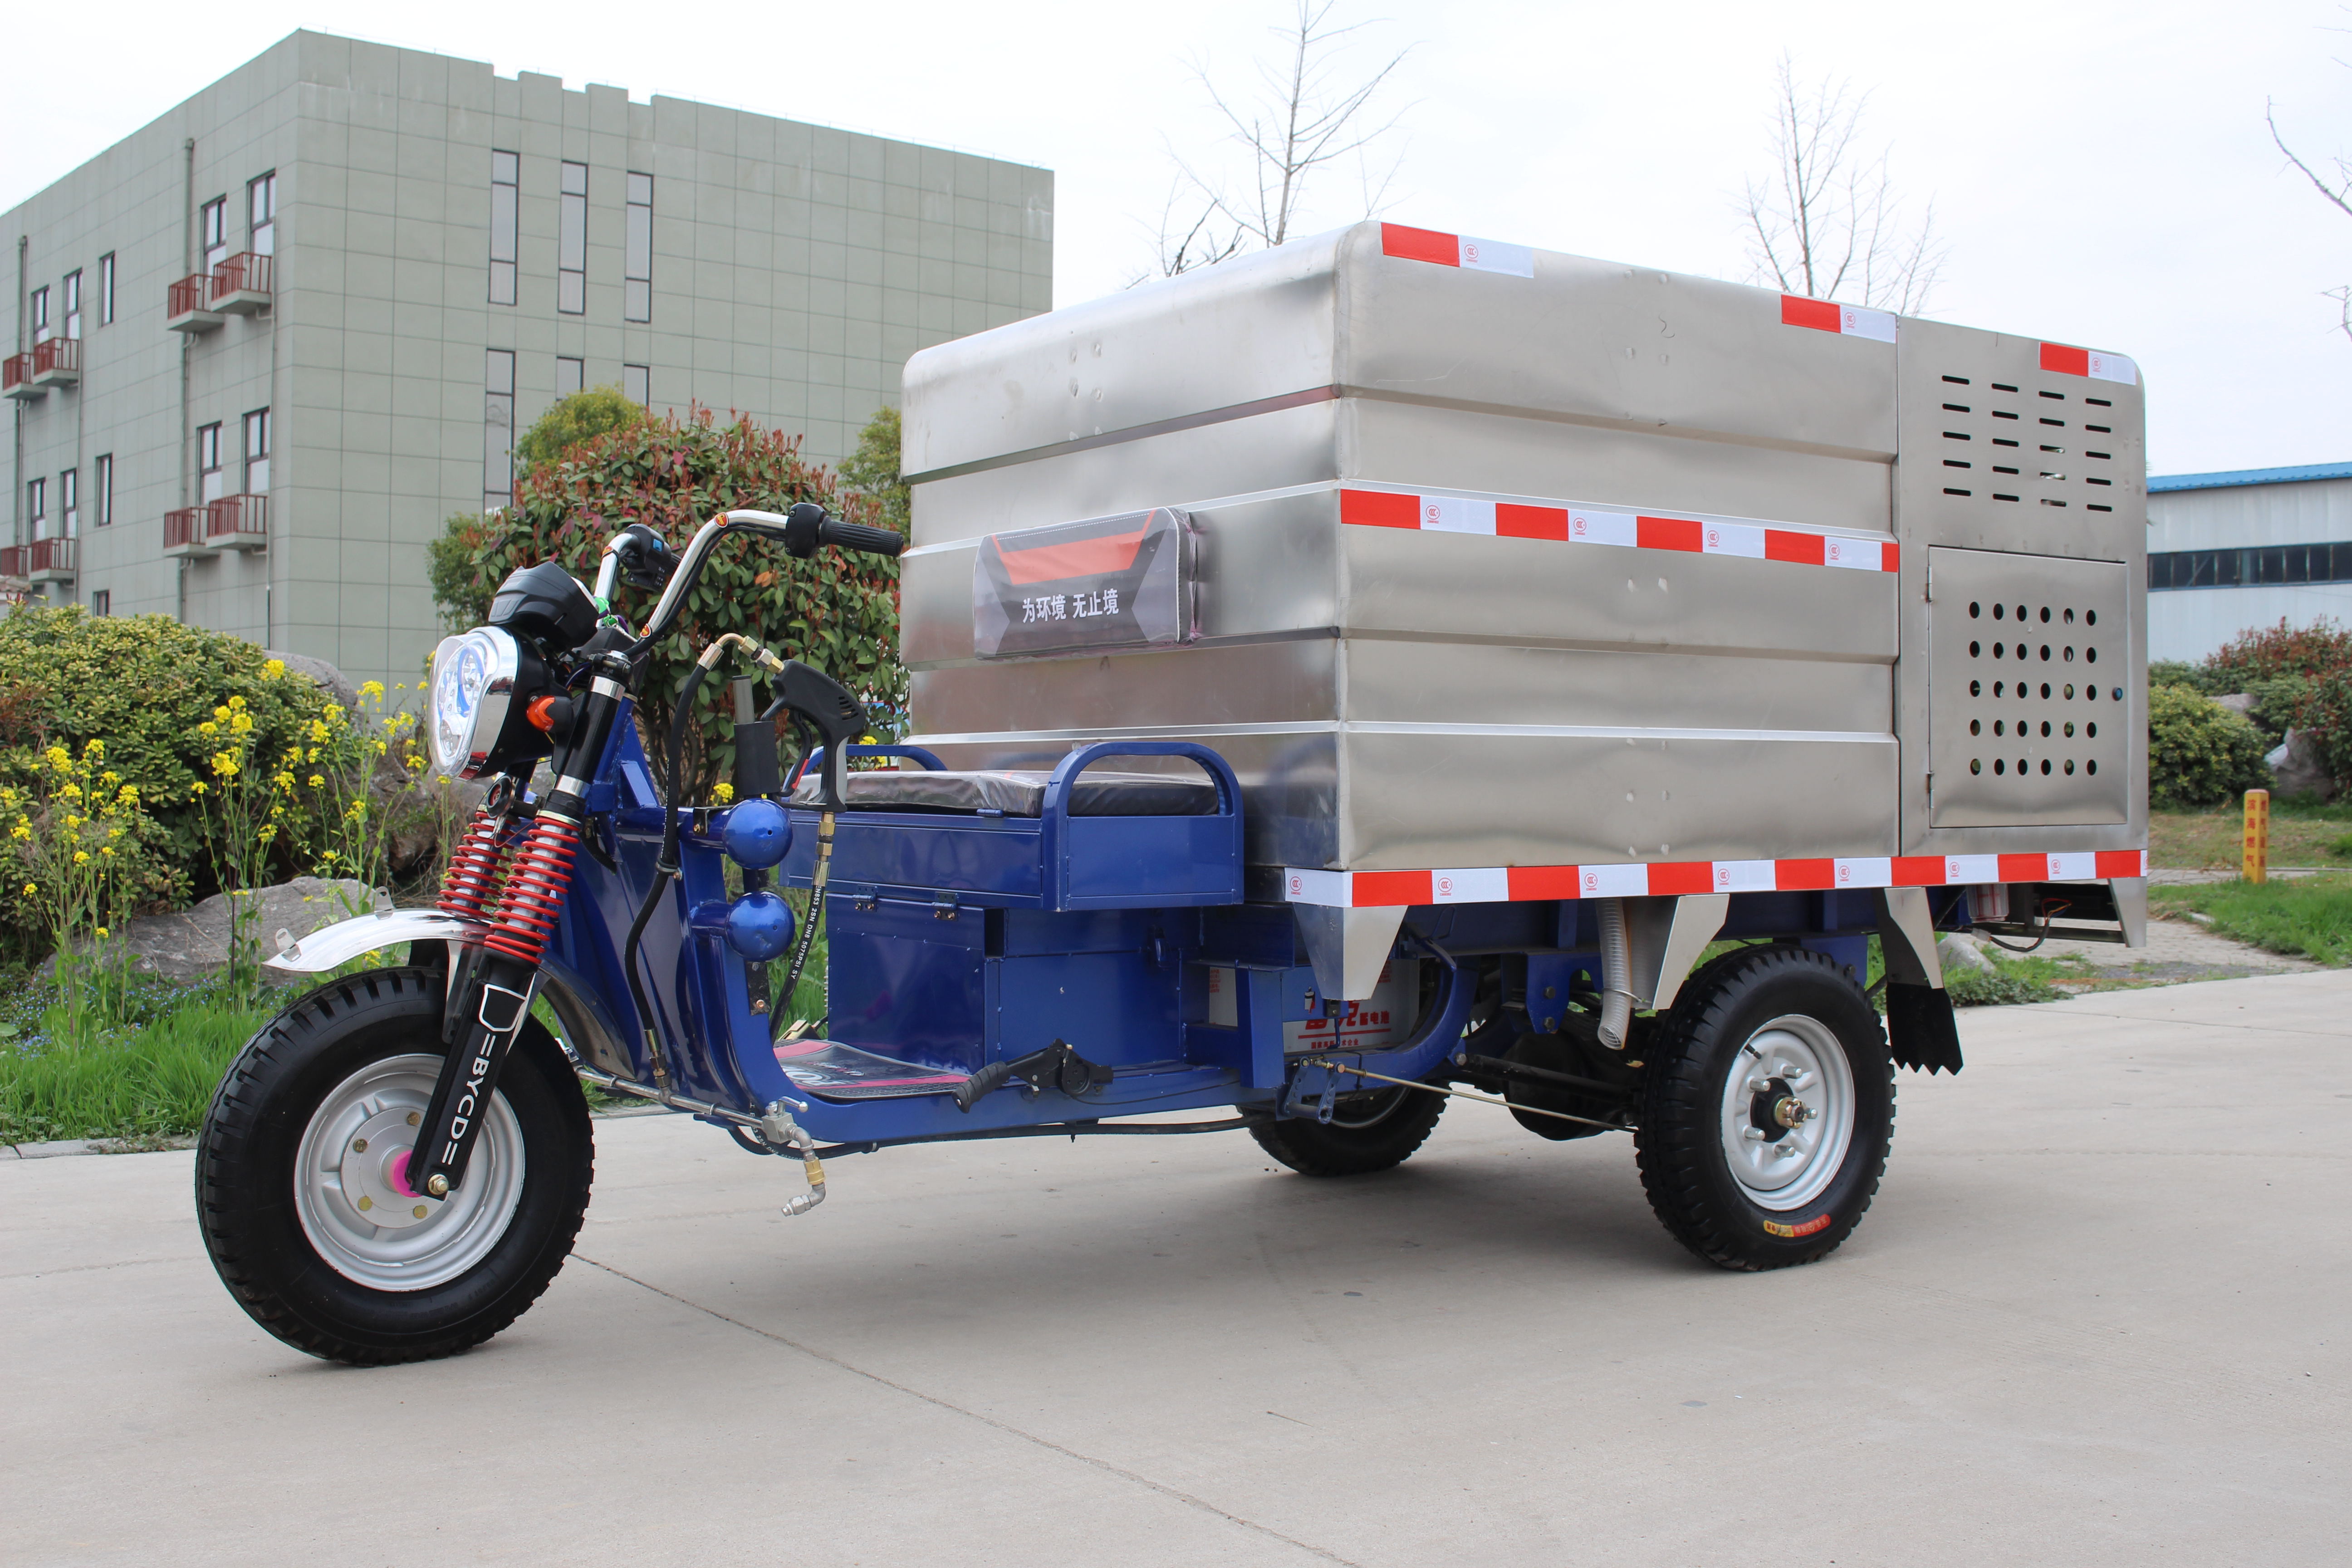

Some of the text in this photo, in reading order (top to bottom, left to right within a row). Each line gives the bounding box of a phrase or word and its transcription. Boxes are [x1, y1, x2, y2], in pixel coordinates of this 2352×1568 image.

[1022, 588, 1119, 624] 为环境 无止境
[804, 924, 813, 939] DN8
[794, 941, 808, 968] 5075PSI
[791, 969, 798, 980] SY
[451, 1057, 490, 1140] BYCD
